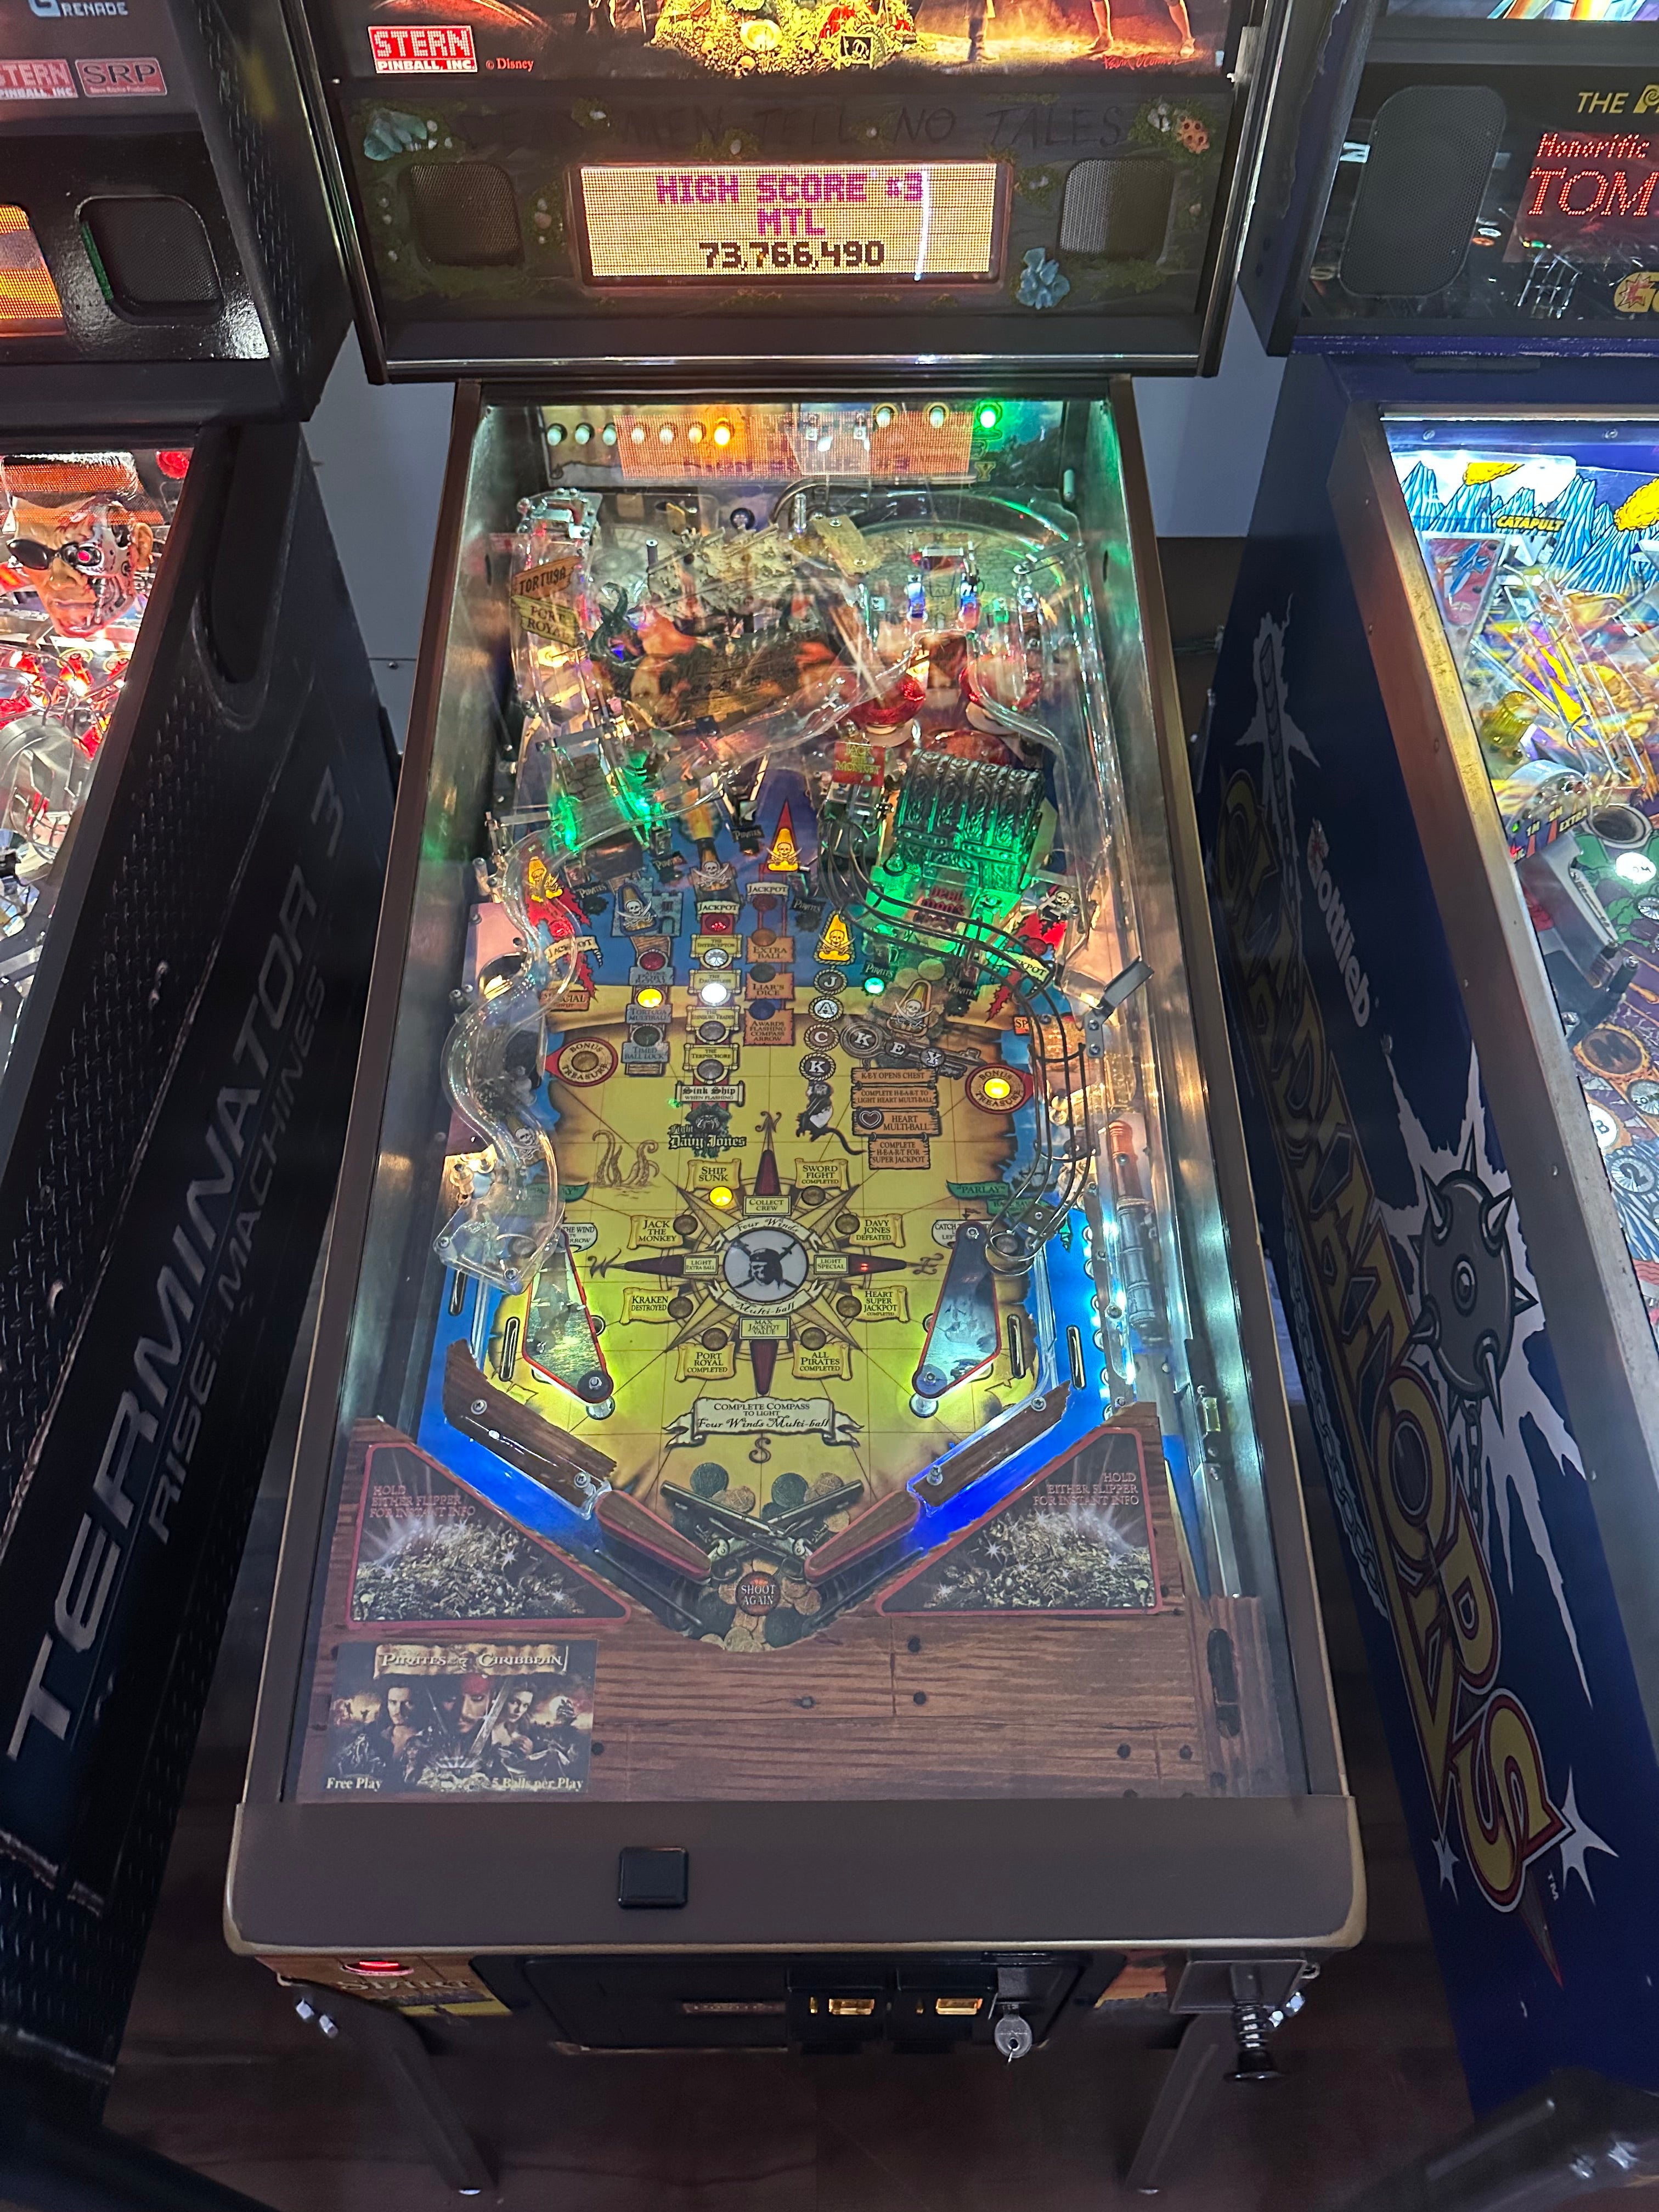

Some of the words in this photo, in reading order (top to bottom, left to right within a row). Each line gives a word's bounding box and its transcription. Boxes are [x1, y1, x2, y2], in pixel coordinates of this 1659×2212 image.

[374, 30, 471, 57] STERN
[377, 60, 446, 71] PINBALL,
[447, 59, 476, 70] INC.
[496, 57, 534, 71] Disney
[0, 64, 70, 86] TERN
[83, 64, 156, 84] SRP
[1577, 92, 1629, 114] THE
[896, 108, 956, 143] NO
[988, 107, 1122, 146] TALES
[1537, 133, 1650, 159] Honorific
[656, 175, 739, 204] HIGH
[756, 173, 867, 204] SCORE
[757, 208, 826, 236] MTL
[698, 240, 884, 271] 73,766,490
[1497, 515, 1566, 532] CATAPULT
[519, 566, 566, 596] TORTUGA
[531, 605, 566, 623] PORT
[527, 618, 571, 639] ROYAL
[845, 743, 873, 756] JACK
[834, 760, 881, 775] MONKEY
[312, 765, 345, 858] 3
[1559, 808, 1588, 832] EXTRA
[578, 884, 607, 899] PIRATES
[548, 938, 593, 958] JACKOT
[865, 963, 894, 978] PIRATES
[948, 981, 977, 996] PIRATES
[569, 1042, 603, 1053] BONUS
[561, 1063, 610, 1081] TREASURE
[979, 1070, 1013, 1081] BONUS
[682, 1086, 708, 1094] Sink
[711, 1086, 736, 1096] Ship
[218, 967, 328, 1311] MACHINES
[669, 1134, 703, 1149] Davy
[707, 1134, 746, 1147] Jones
[701, 1166, 726, 1175] SHIP
[1620, 1162, 1647, 1187] 2
[643, 1219, 670, 1229] JACK
[735, 1222, 759, 1232] Four
[765, 1217, 799, 1232] Winds
[865, 1219, 889, 1227] DAVY
[631, 1295, 669, 1304] KRAKEN
[7, 864, 317, 1760] TERMINATOR
[697, 1418, 723, 1428] Four
[726, 1417, 765, 1427] Winds
[766, 1415, 831, 1427] Multi-ball
[147, 1340, 217, 1544] RISE
[1103, 1472, 1137, 1482] HOLD
[373, 1485, 407, 1496] HOLD
[1047, 1484, 1090, 1494] EITHER
[371, 1497, 413, 1507] EITHER
[416, 1495, 461, 1506] FLIPPER
[1032, 1496, 1057, 1506] FOR
[1058, 1496, 1109, 1505] INSTANT
[1111, 1496, 1139, 1505] INFO
[369, 1508, 393, 1518] FOR
[395, 1506, 446, 1517] INSTANT
[448, 1505, 476, 1517] INFO
[741, 1584, 776, 1594] SHOOT
[743, 1596, 774, 1605] AGAIN
[381, 1653, 447, 1667] PIRATES
[478, 1653, 563, 1667] CARIBBEAN
[326, 1778, 353, 1789] Free
[356, 1778, 383, 1792] Play
[557, 1777, 584, 1792] Play
